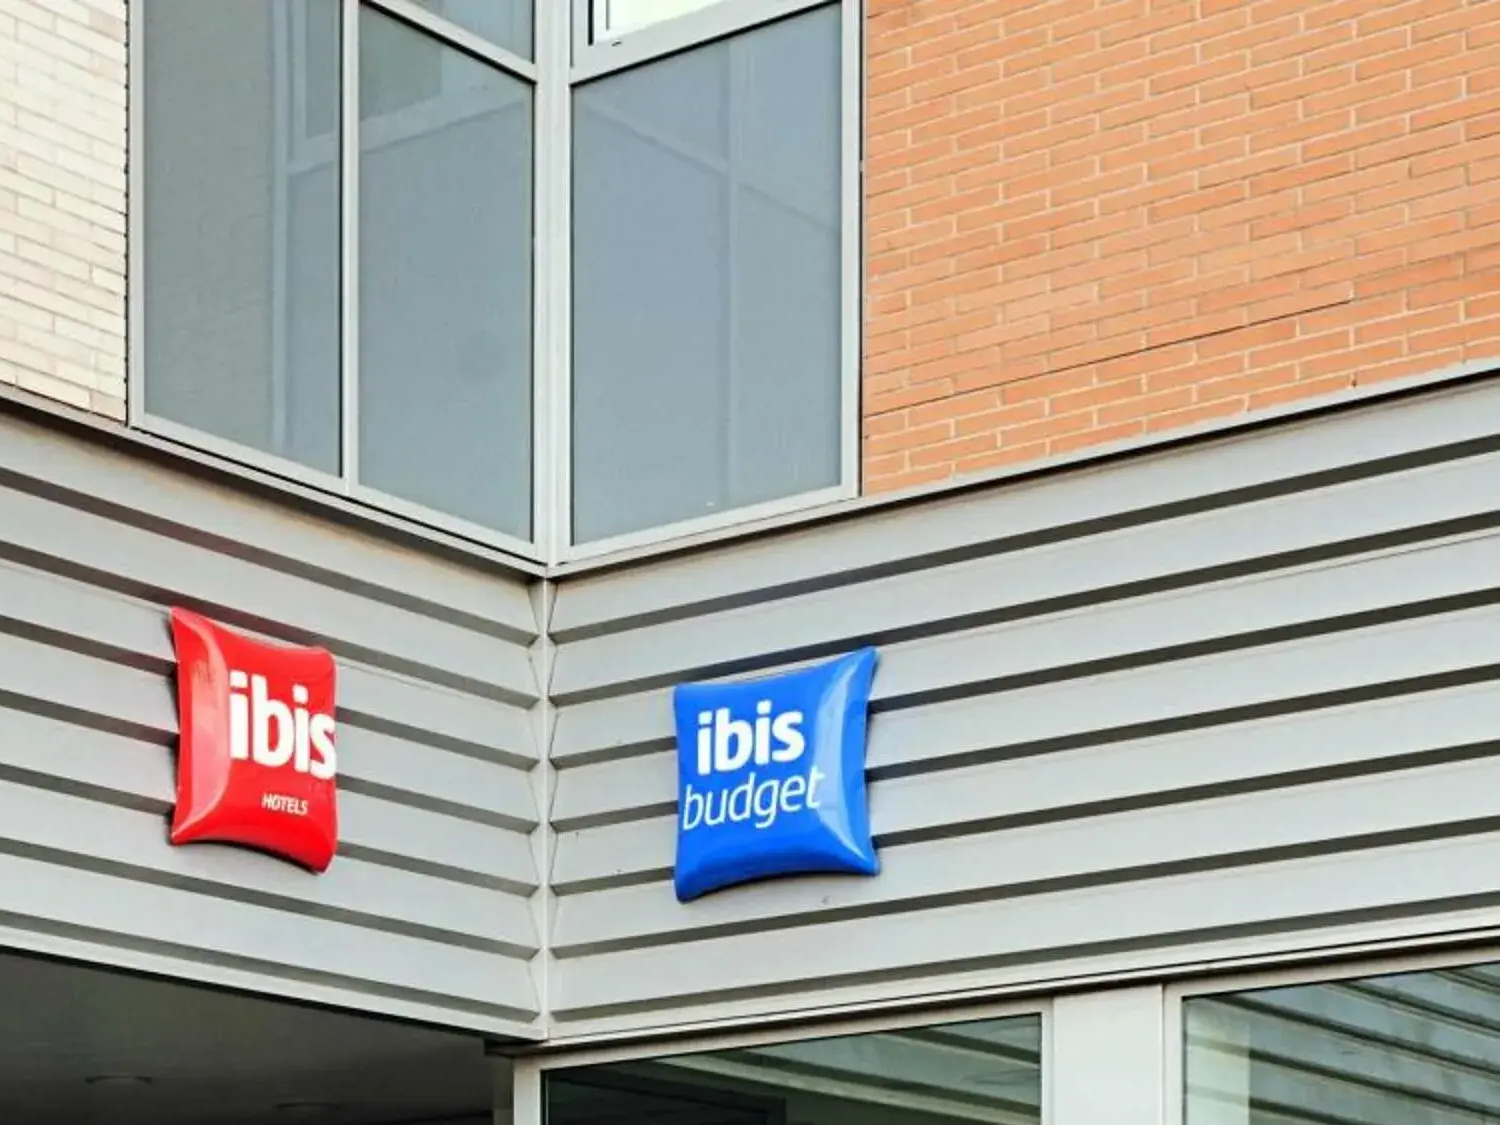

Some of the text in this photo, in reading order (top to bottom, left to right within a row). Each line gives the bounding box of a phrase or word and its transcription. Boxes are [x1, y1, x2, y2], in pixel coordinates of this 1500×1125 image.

[229, 669, 337, 780] ibis
[696, 698, 807, 776] ibis
[260, 792, 309, 816] HOTELS
[682, 763, 827, 831] budget
